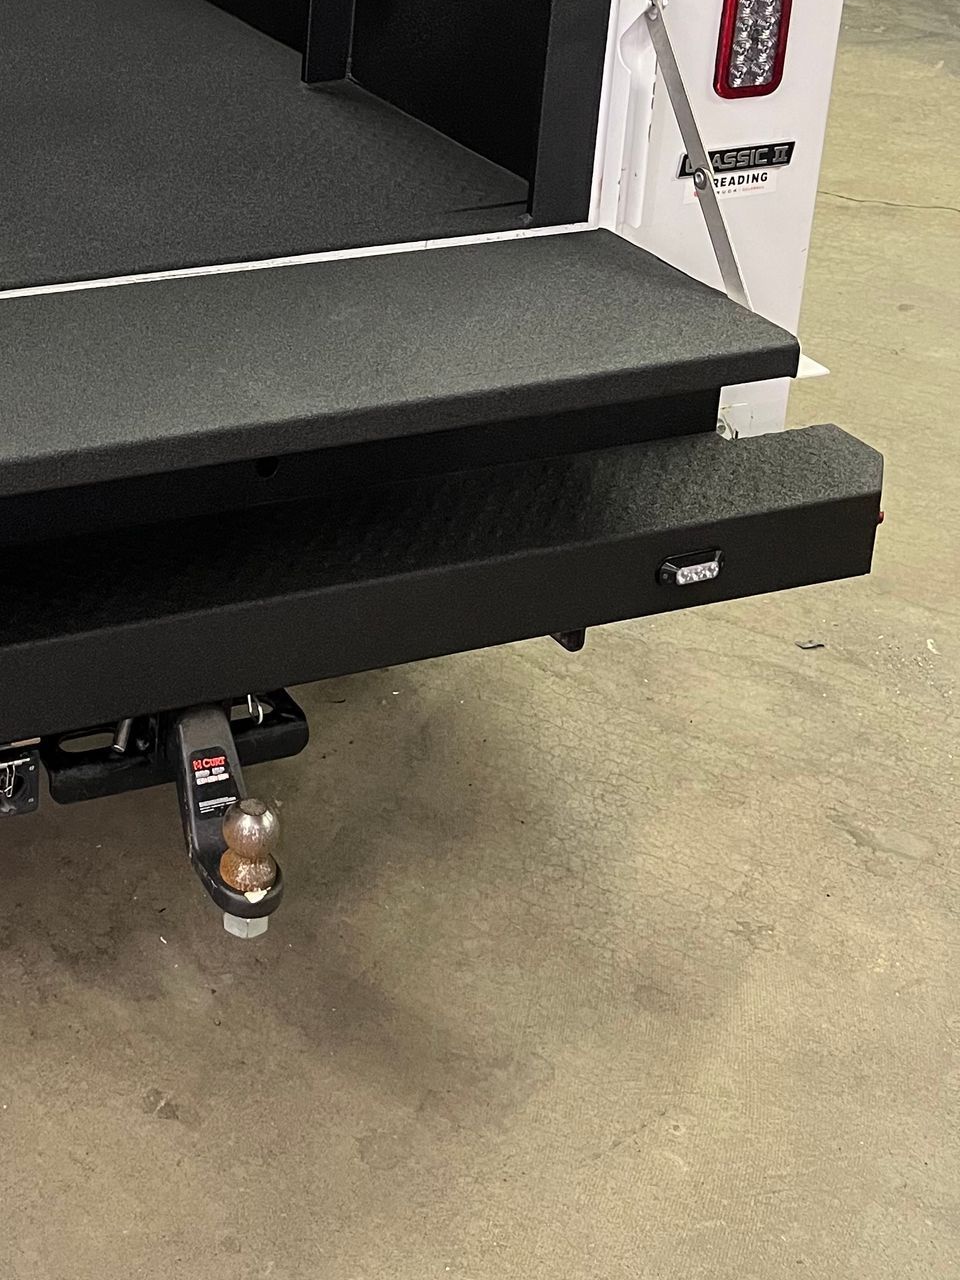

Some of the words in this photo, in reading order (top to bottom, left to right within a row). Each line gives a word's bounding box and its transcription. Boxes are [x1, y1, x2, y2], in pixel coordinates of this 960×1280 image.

[685, 148, 769, 173] CASSIC
[714, 172, 768, 188] READING
[202, 756, 225, 767] CURT
